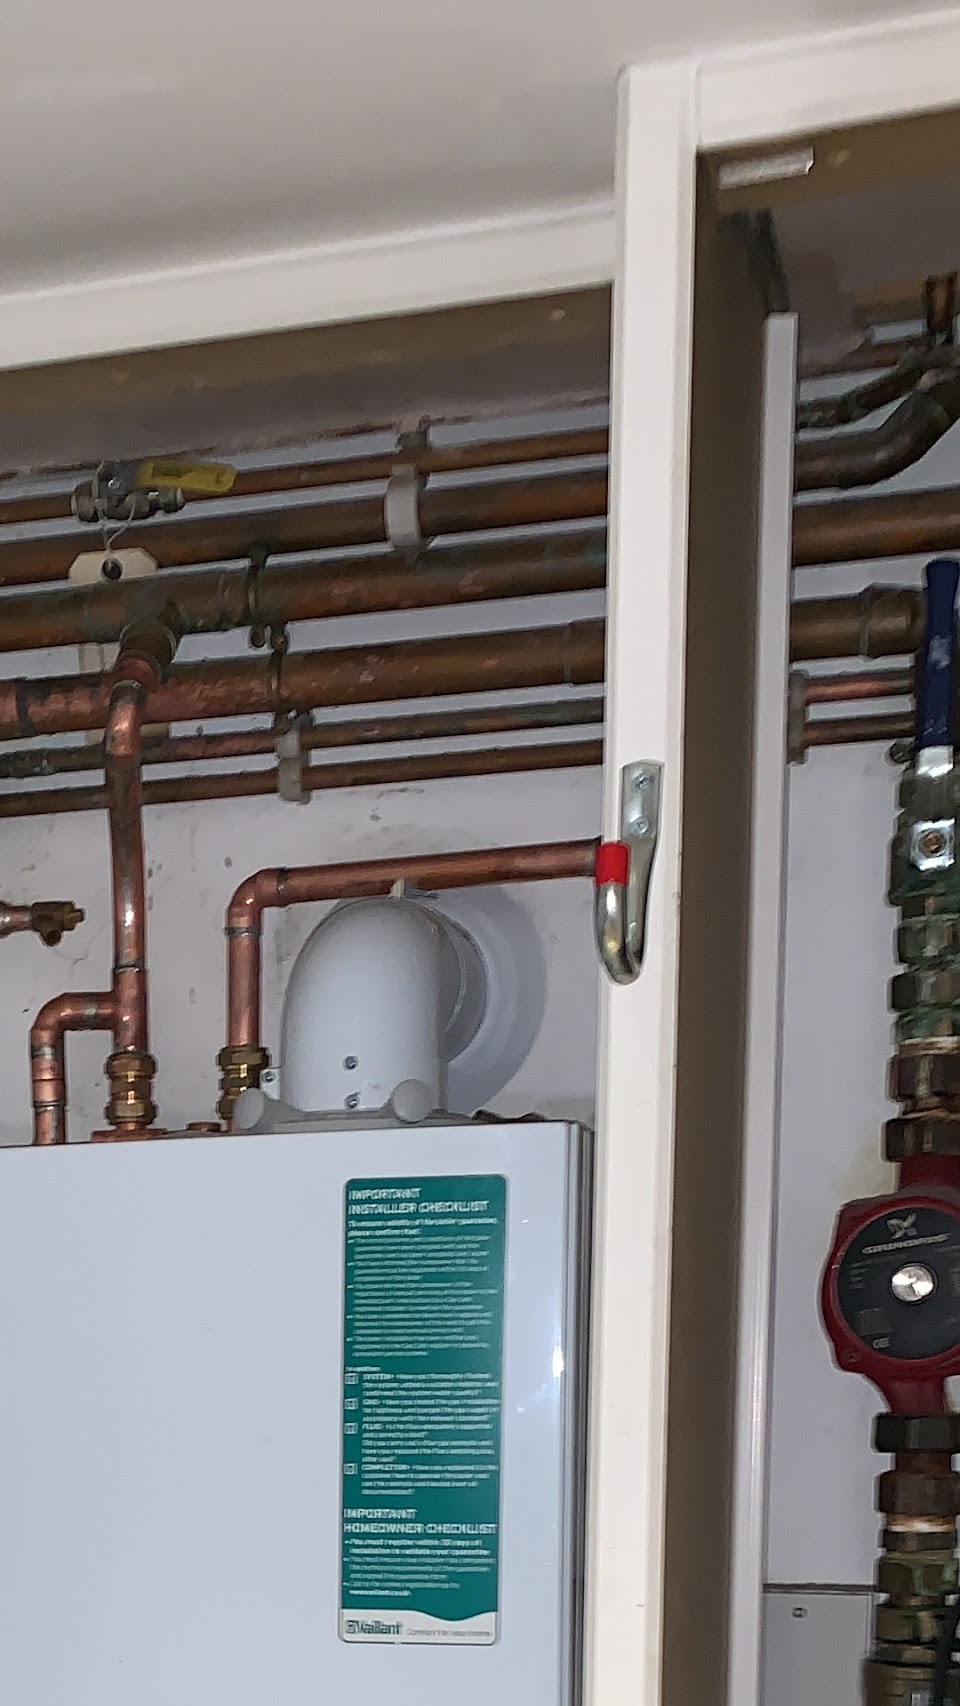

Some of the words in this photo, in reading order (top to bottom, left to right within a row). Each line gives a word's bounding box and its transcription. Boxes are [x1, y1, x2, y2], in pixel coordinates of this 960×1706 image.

[348, 1188, 422, 1200] IMPORTANT
[348, 1203, 417, 1215] INSTALLER
[418, 1201, 490, 1213] CHECKLIST
[343, 1508, 418, 1519] IMPORTANT
[343, 1523, 424, 1534] HOMEOWNER
[425, 1523, 497, 1534] CHECKLIST
[357, 1620, 402, 1635] Vaillant
